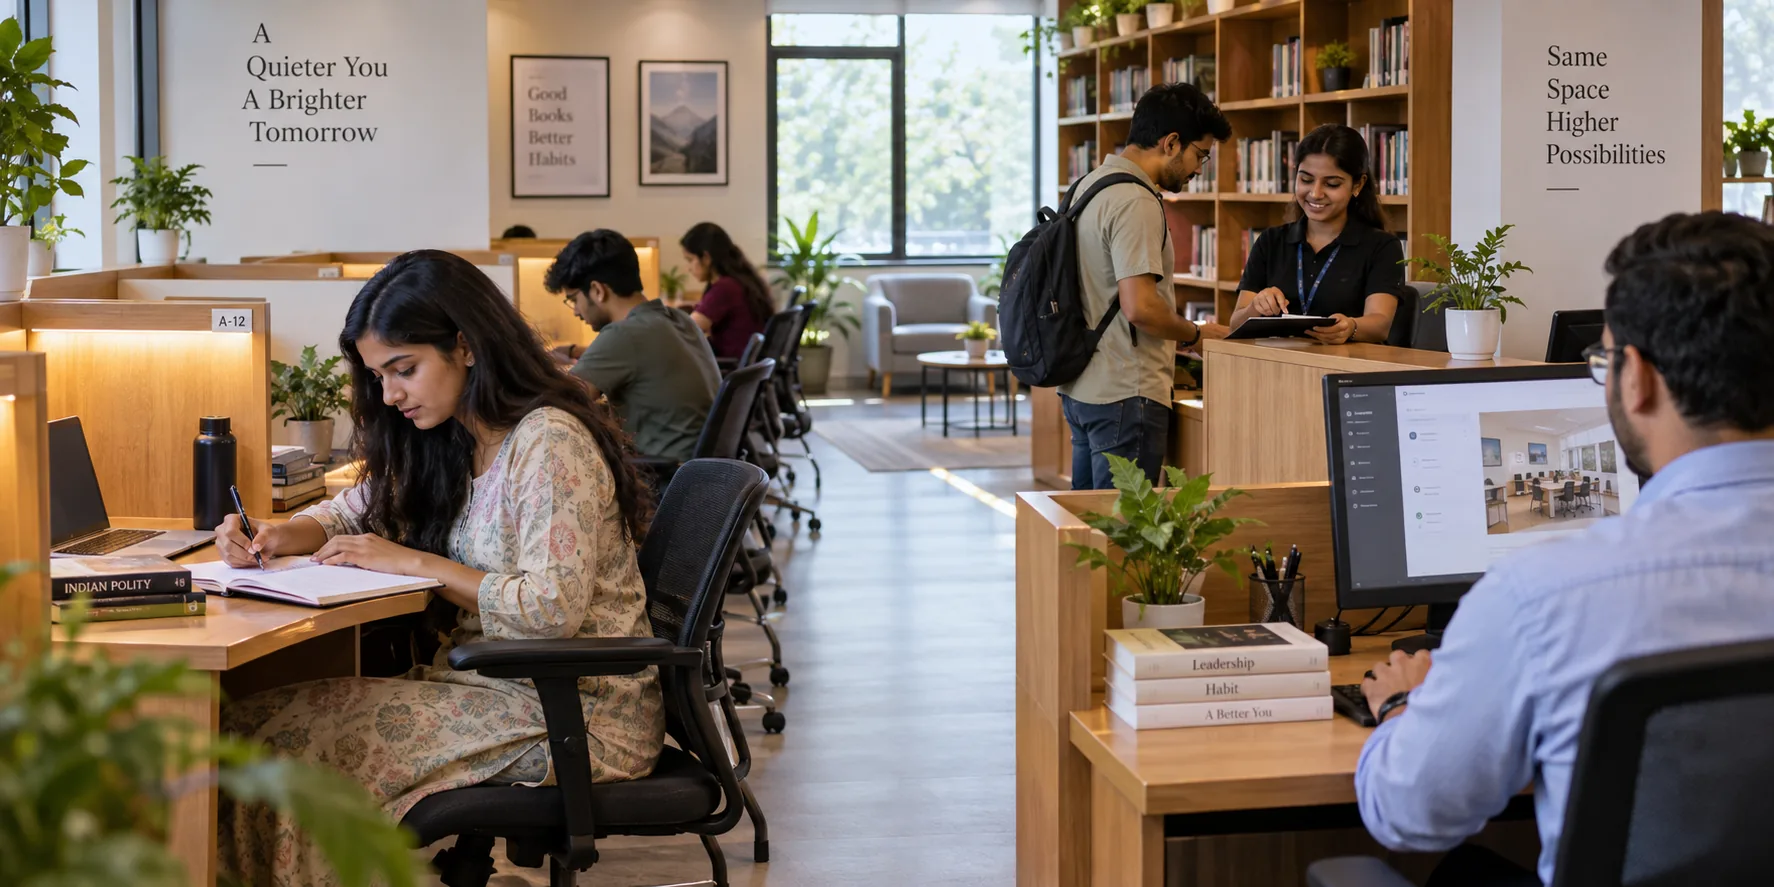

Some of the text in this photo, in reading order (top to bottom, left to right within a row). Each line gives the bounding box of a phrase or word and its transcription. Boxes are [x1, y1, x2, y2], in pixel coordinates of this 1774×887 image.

[252, 23, 271, 44] A
[1547, 45, 1607, 66] Same
[246, 56, 388, 81] Quieter You
[527, 86, 568, 102] Good
[1547, 78, 1609, 105] Space
[242, 88, 367, 116] A Brighter
[528, 107, 574, 123] Books
[249, 122, 378, 142] Tomorrow
[1546, 111, 1619, 138] Higher
[528, 130, 573, 145] Better
[528, 151, 577, 167] Habits
[1546, 144, 1666, 165] Possibilities
[218, 315, 246, 327] A-12
[64, 579, 152, 594] INDIAN POLITY
[1192, 656, 1255, 672] Leadership
[1205, 682, 1239, 696] Habit
[1205, 707, 1273, 721] A Better You
